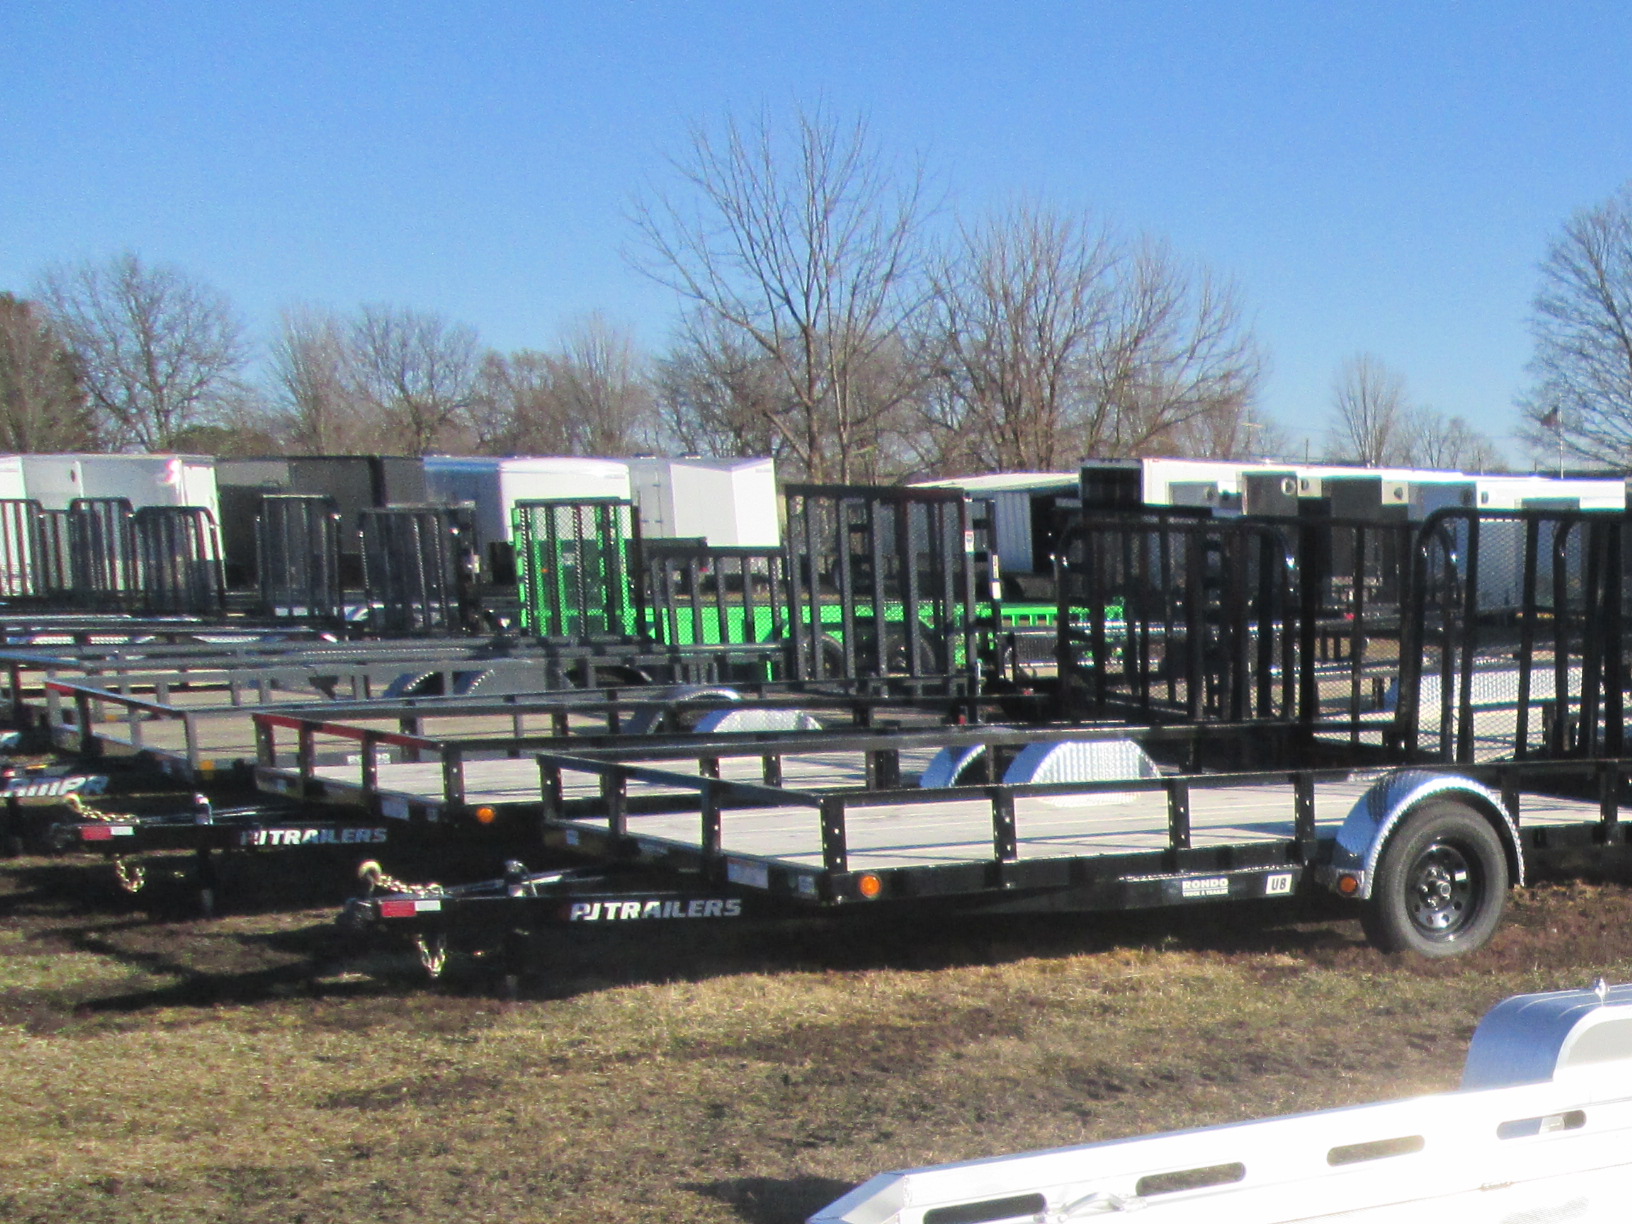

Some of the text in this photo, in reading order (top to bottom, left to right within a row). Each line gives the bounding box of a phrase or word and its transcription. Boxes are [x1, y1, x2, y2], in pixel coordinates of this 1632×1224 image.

[268, 828, 388, 845] TRAILERS
[1181, 878, 1229, 889] RONDO
[569, 899, 742, 922] PJ TRAILERS
